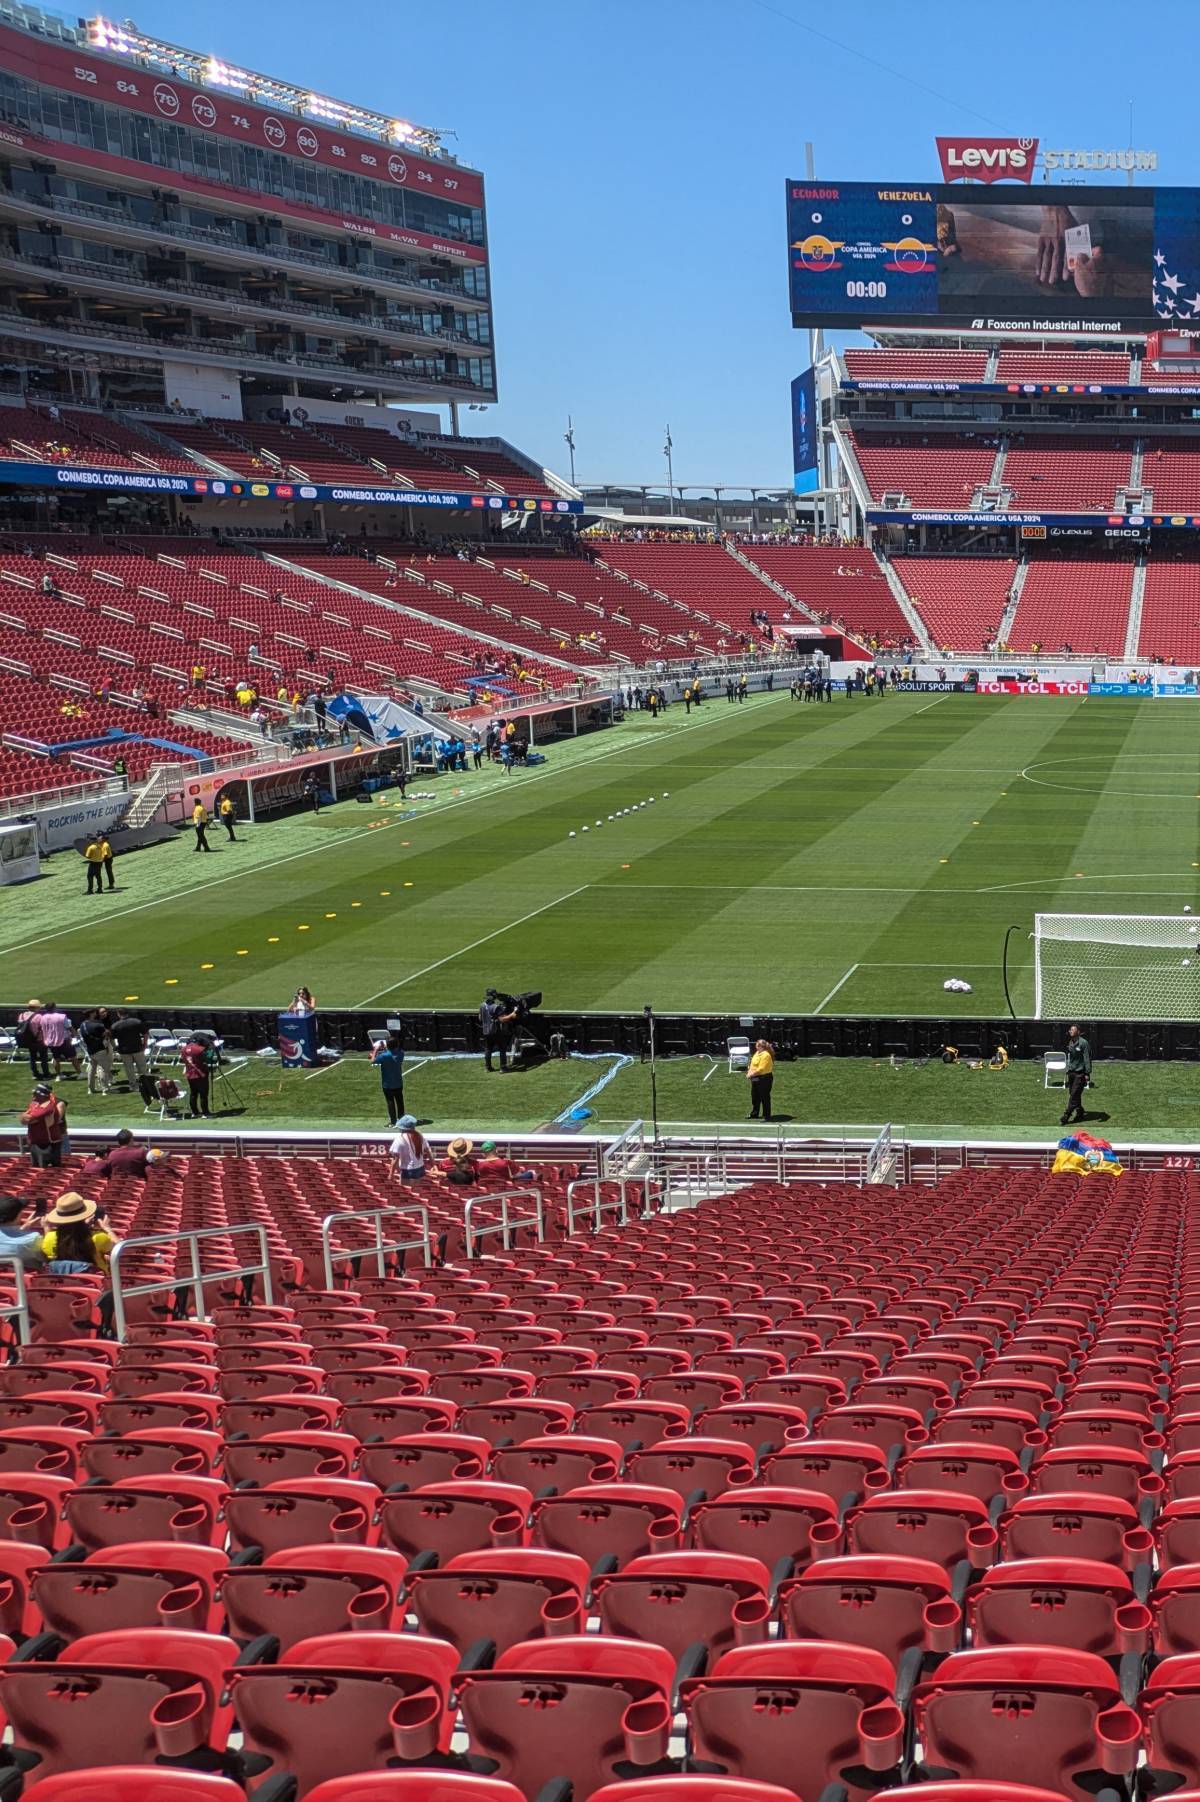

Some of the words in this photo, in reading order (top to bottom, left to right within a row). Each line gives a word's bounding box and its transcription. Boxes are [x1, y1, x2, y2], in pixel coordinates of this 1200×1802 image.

[74, 66, 98, 84] 52
[156, 92, 179, 107] 70
[195, 103, 216, 119] 73
[232, 114, 250, 129] 74
[265, 125, 286, 139] 79
[298, 135, 317, 148] 80
[1043, 149, 1159, 171] STADIUM
[791, 188, 840, 200] ECUADOR
[877, 191, 932, 202] VENEZUELA
[343, 221, 376, 236] WALSH
[858, 246, 888, 254] AMERICA
[846, 281, 887, 298] 00:00
[987, 319, 1031, 330] Foxconn
[1033, 320, 1080, 331] Industrial
[1082, 320, 1121, 332] Internet
[1181, 387, 1198, 395] COPA
[57, 470, 104, 484] CONMEBOL
[104, 472, 124, 486] COPA
[124, 473, 156, 488] AMERICA
[157, 477, 172, 489] USA
[171, 479, 188, 491] 2024
[332, 489, 374, 500] CONMEBOL
[375, 491, 394, 502] COPA
[394, 492, 427, 504] AMERICA
[428, 495, 441, 504] USA
[442, 495, 458, 505] 2024
[911, 513, 953, 521] CONMEBOL
[973, 514, 1007, 522] AMERICA
[1007, 515, 1023, 523] USA
[1023, 515, 1041, 523] 2024
[1104, 529, 1140, 537] GEICO
[928, 682, 955, 691] SPORT
[977, 682, 1010, 693] TCL
[1016, 682, 1050, 694] TCL
[1056, 683, 1088, 694] TCL
[1090, 685, 1123, 694] BYD
[1164, 686, 1197, 694] BYD
[47, 813, 85, 829] ROCKING
[85, 806, 104, 820] THE
[361, 1144, 387, 1156] 128
[1165, 1157, 1191, 1168] 127
